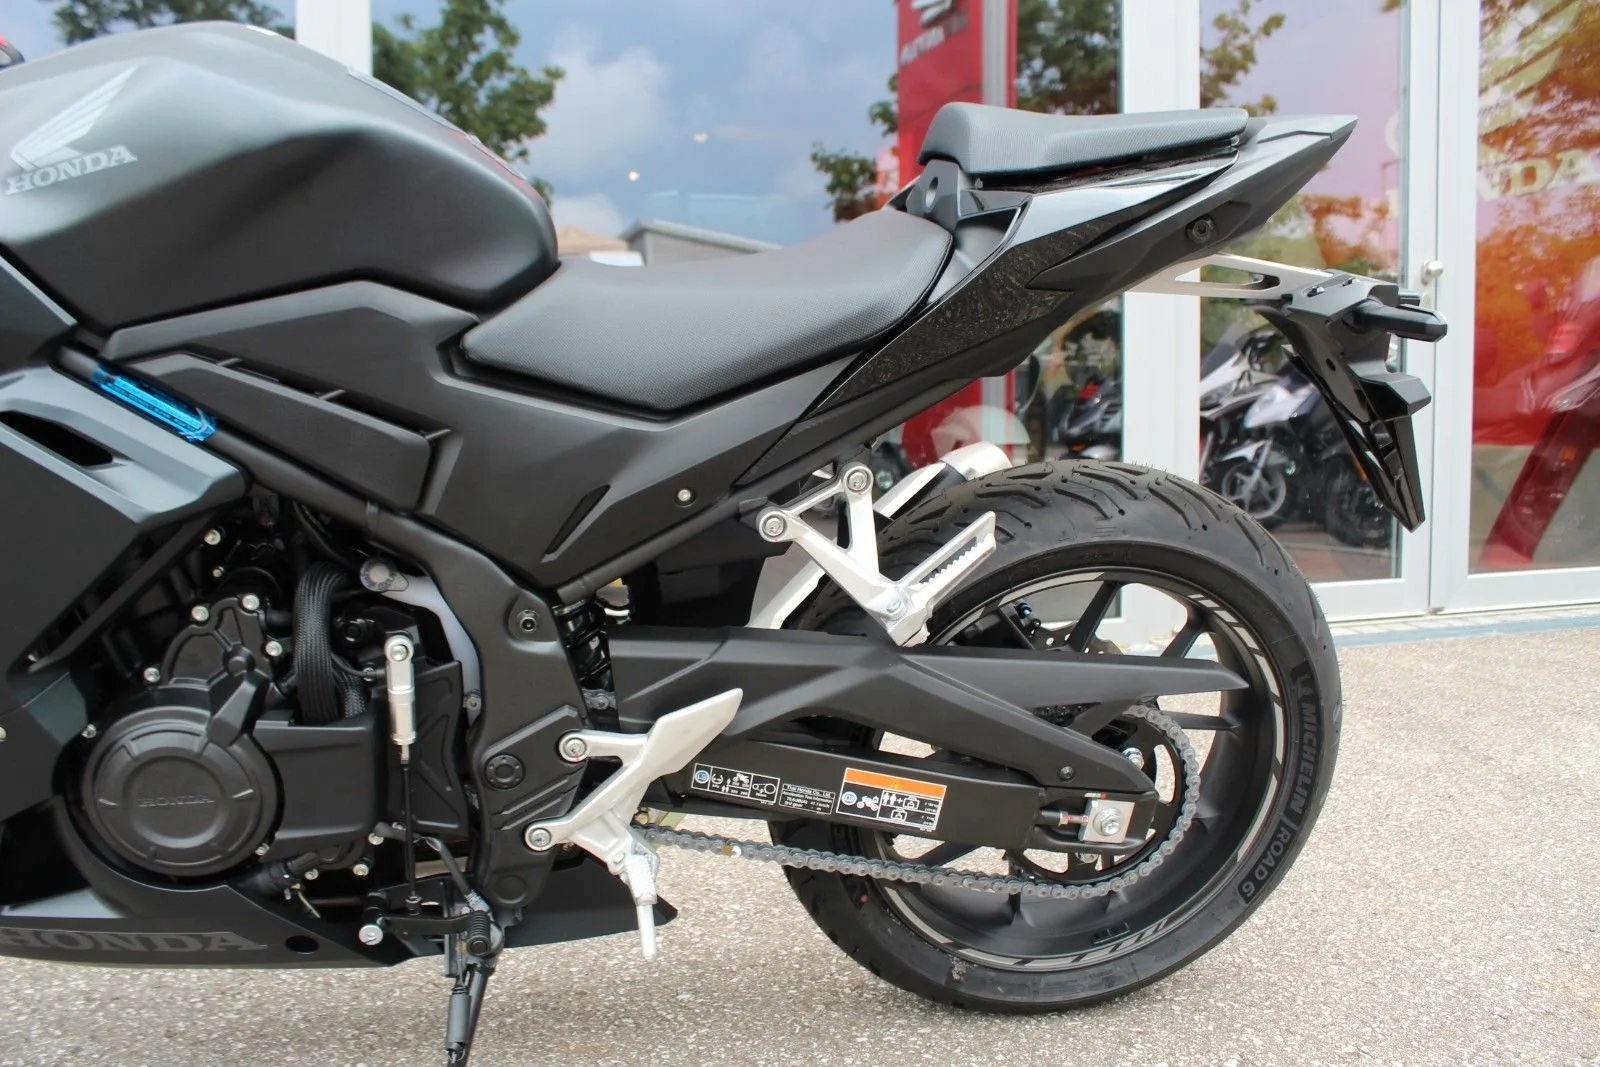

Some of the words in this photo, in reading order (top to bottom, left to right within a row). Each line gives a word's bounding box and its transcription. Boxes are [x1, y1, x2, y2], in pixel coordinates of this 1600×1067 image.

[5, 144, 138, 196] HONDA
[1291, 703, 1317, 815] MICHELIN
[136, 793, 216, 808] HONDA
[1254, 825, 1292, 882] ROAD
[1241, 880, 1256, 898] 6
[0, 926, 268, 952] HONDA
